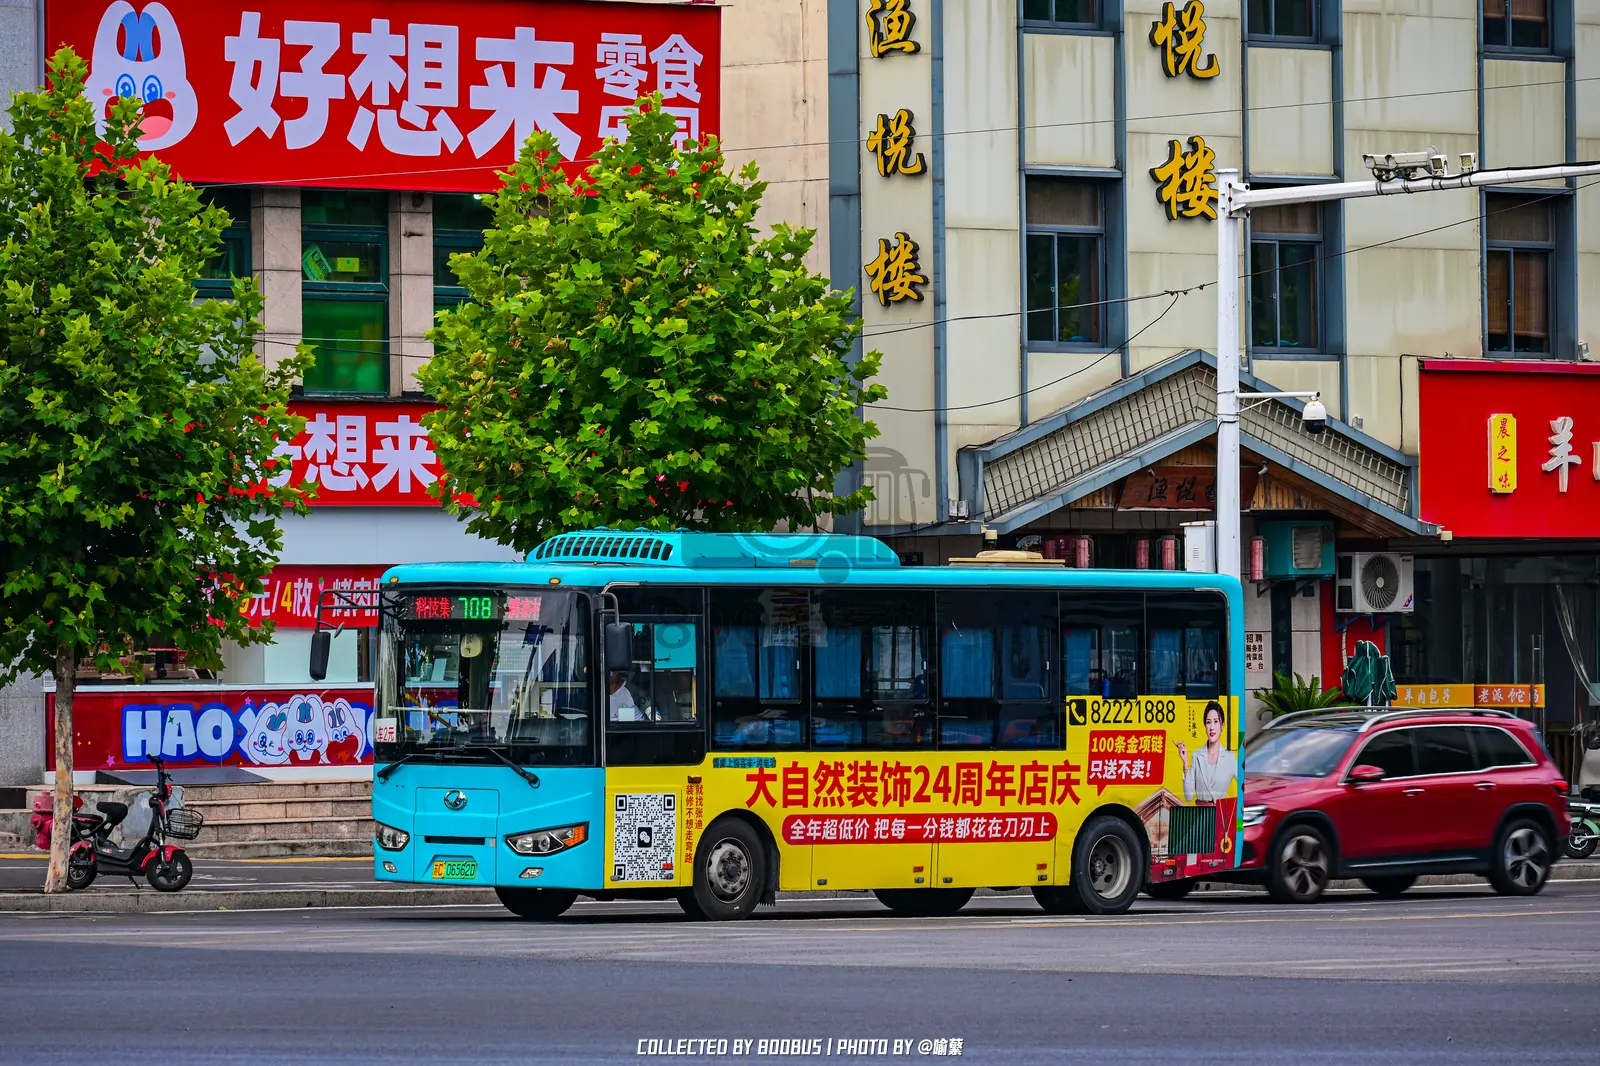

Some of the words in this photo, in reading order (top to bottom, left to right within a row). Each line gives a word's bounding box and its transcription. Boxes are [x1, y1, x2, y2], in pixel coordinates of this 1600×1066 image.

[595, 32, 703, 103] 零食
[224, 11, 582, 161] 好想来
[458, 597, 492, 619] 708
[1404, 688, 1451, 705] 羊肉包子
[1091, 700, 1176, 724] 82221888
[1091, 735, 1164, 754] 100条金项链
[745, 761, 1081, 808] 大自然装饰24周年店庆
[790, 818, 869, 840] 全年超低价
[874, 817, 1050, 839] 把每一分钱都花在刀刃上
